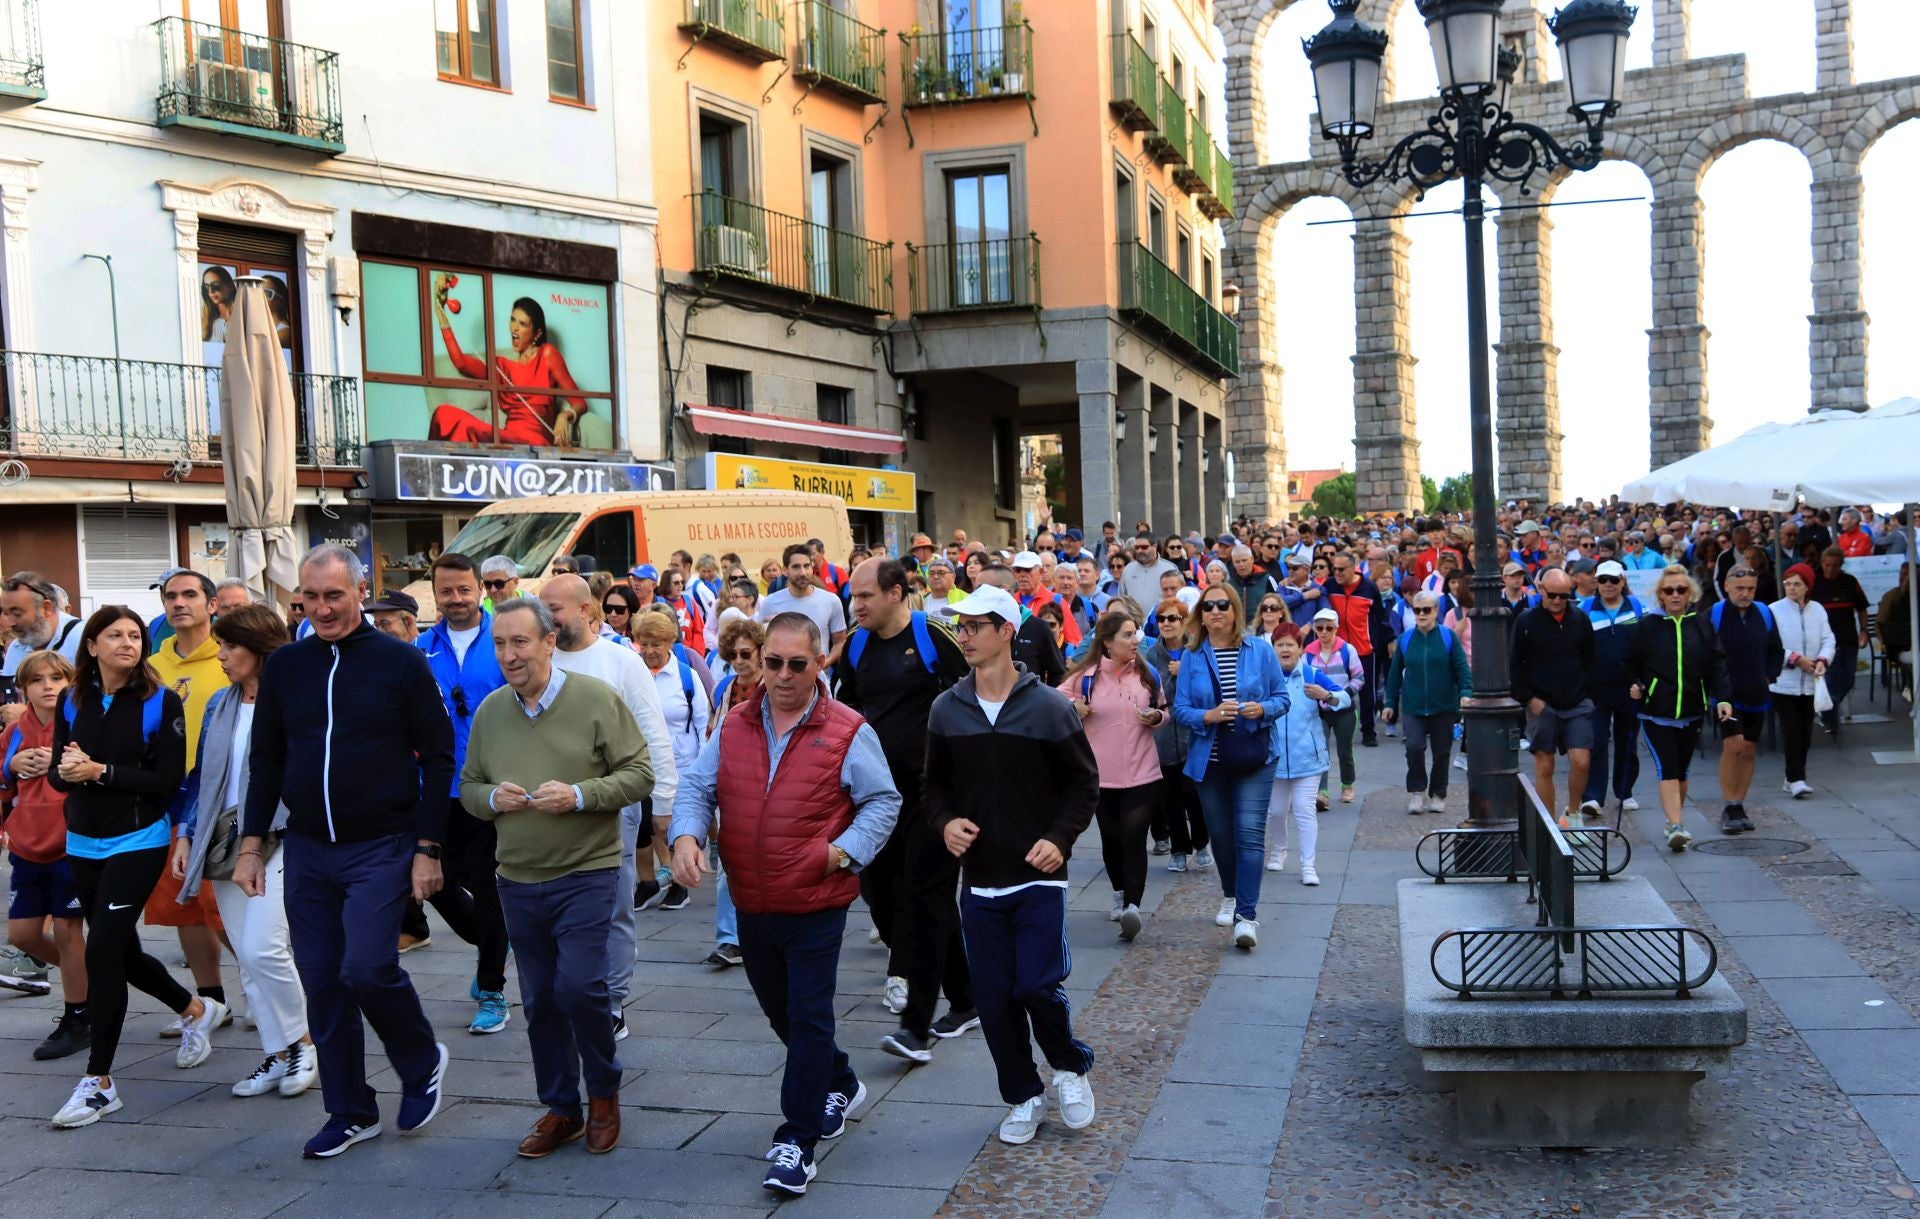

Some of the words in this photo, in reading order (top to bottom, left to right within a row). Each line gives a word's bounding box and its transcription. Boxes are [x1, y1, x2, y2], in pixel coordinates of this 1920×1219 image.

[793, 474, 854, 502] BURBUJA
[688, 523, 704, 541] DE
[706, 523, 721, 540] LA
[723, 522, 755, 540] MATA
[757, 521, 808, 539] ESCOBAR
